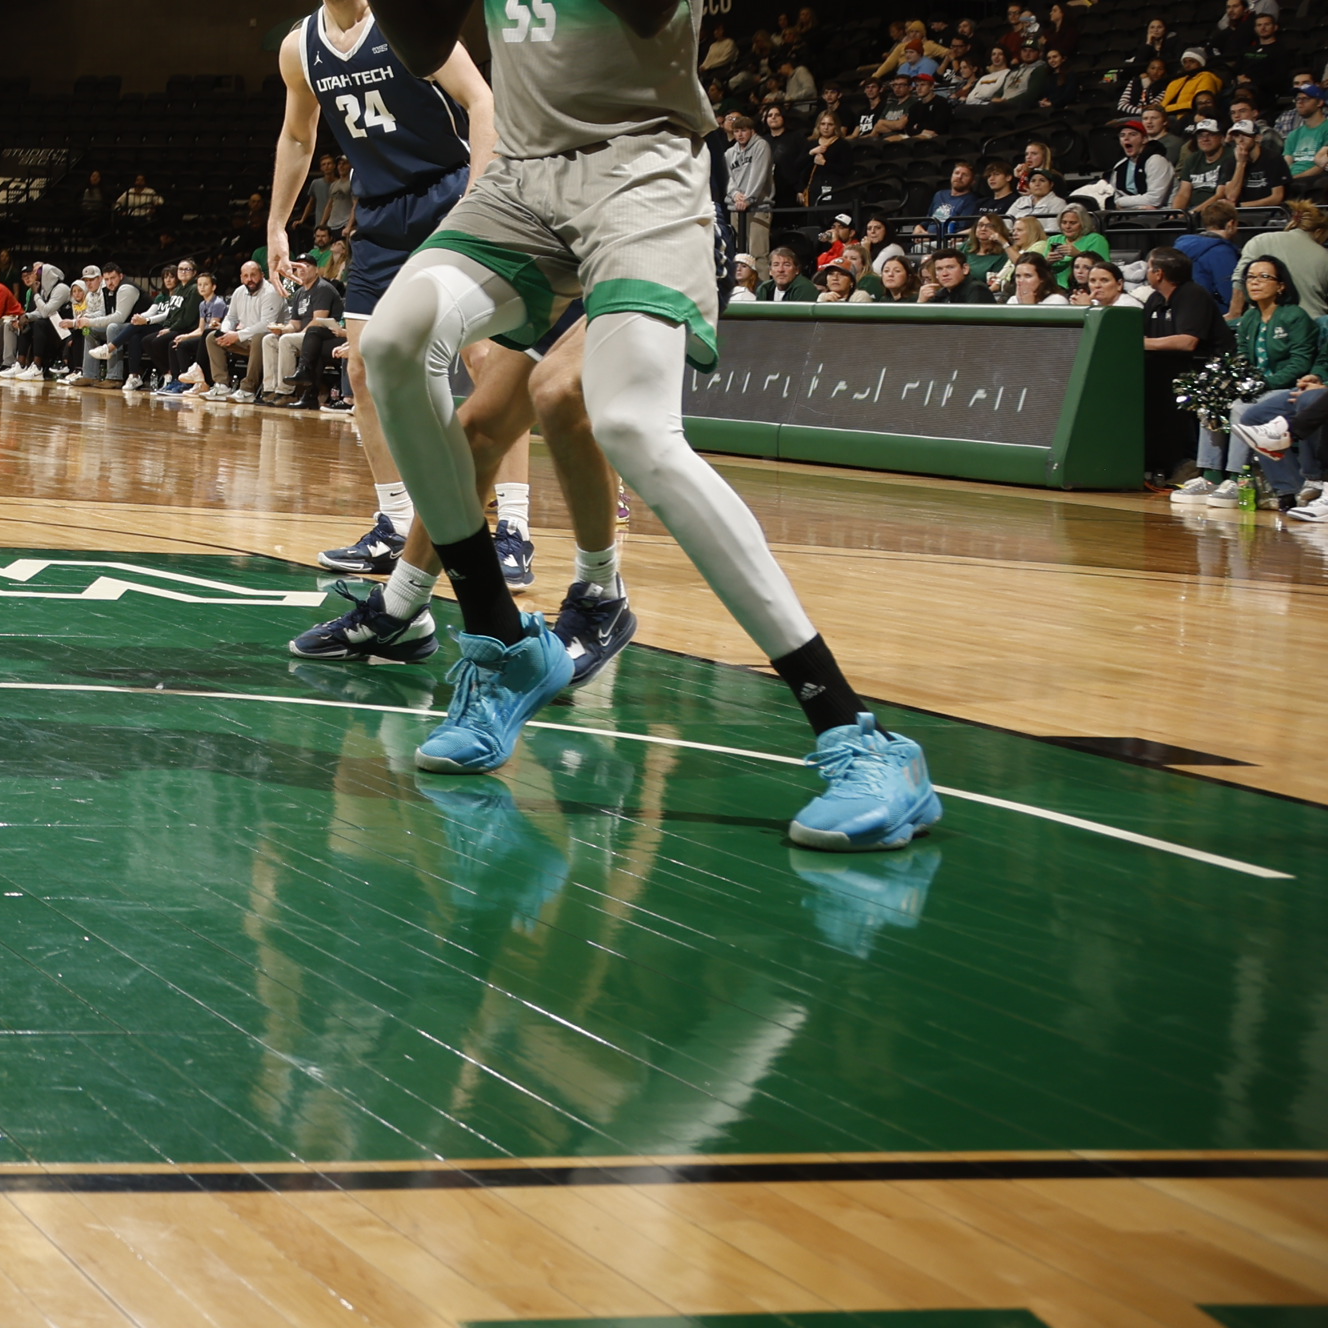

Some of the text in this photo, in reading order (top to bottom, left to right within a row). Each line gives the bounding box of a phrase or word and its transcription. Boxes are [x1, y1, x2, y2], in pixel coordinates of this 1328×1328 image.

[316, 66, 394, 92] UTAH TECH
[336, 90, 397, 138] 24
